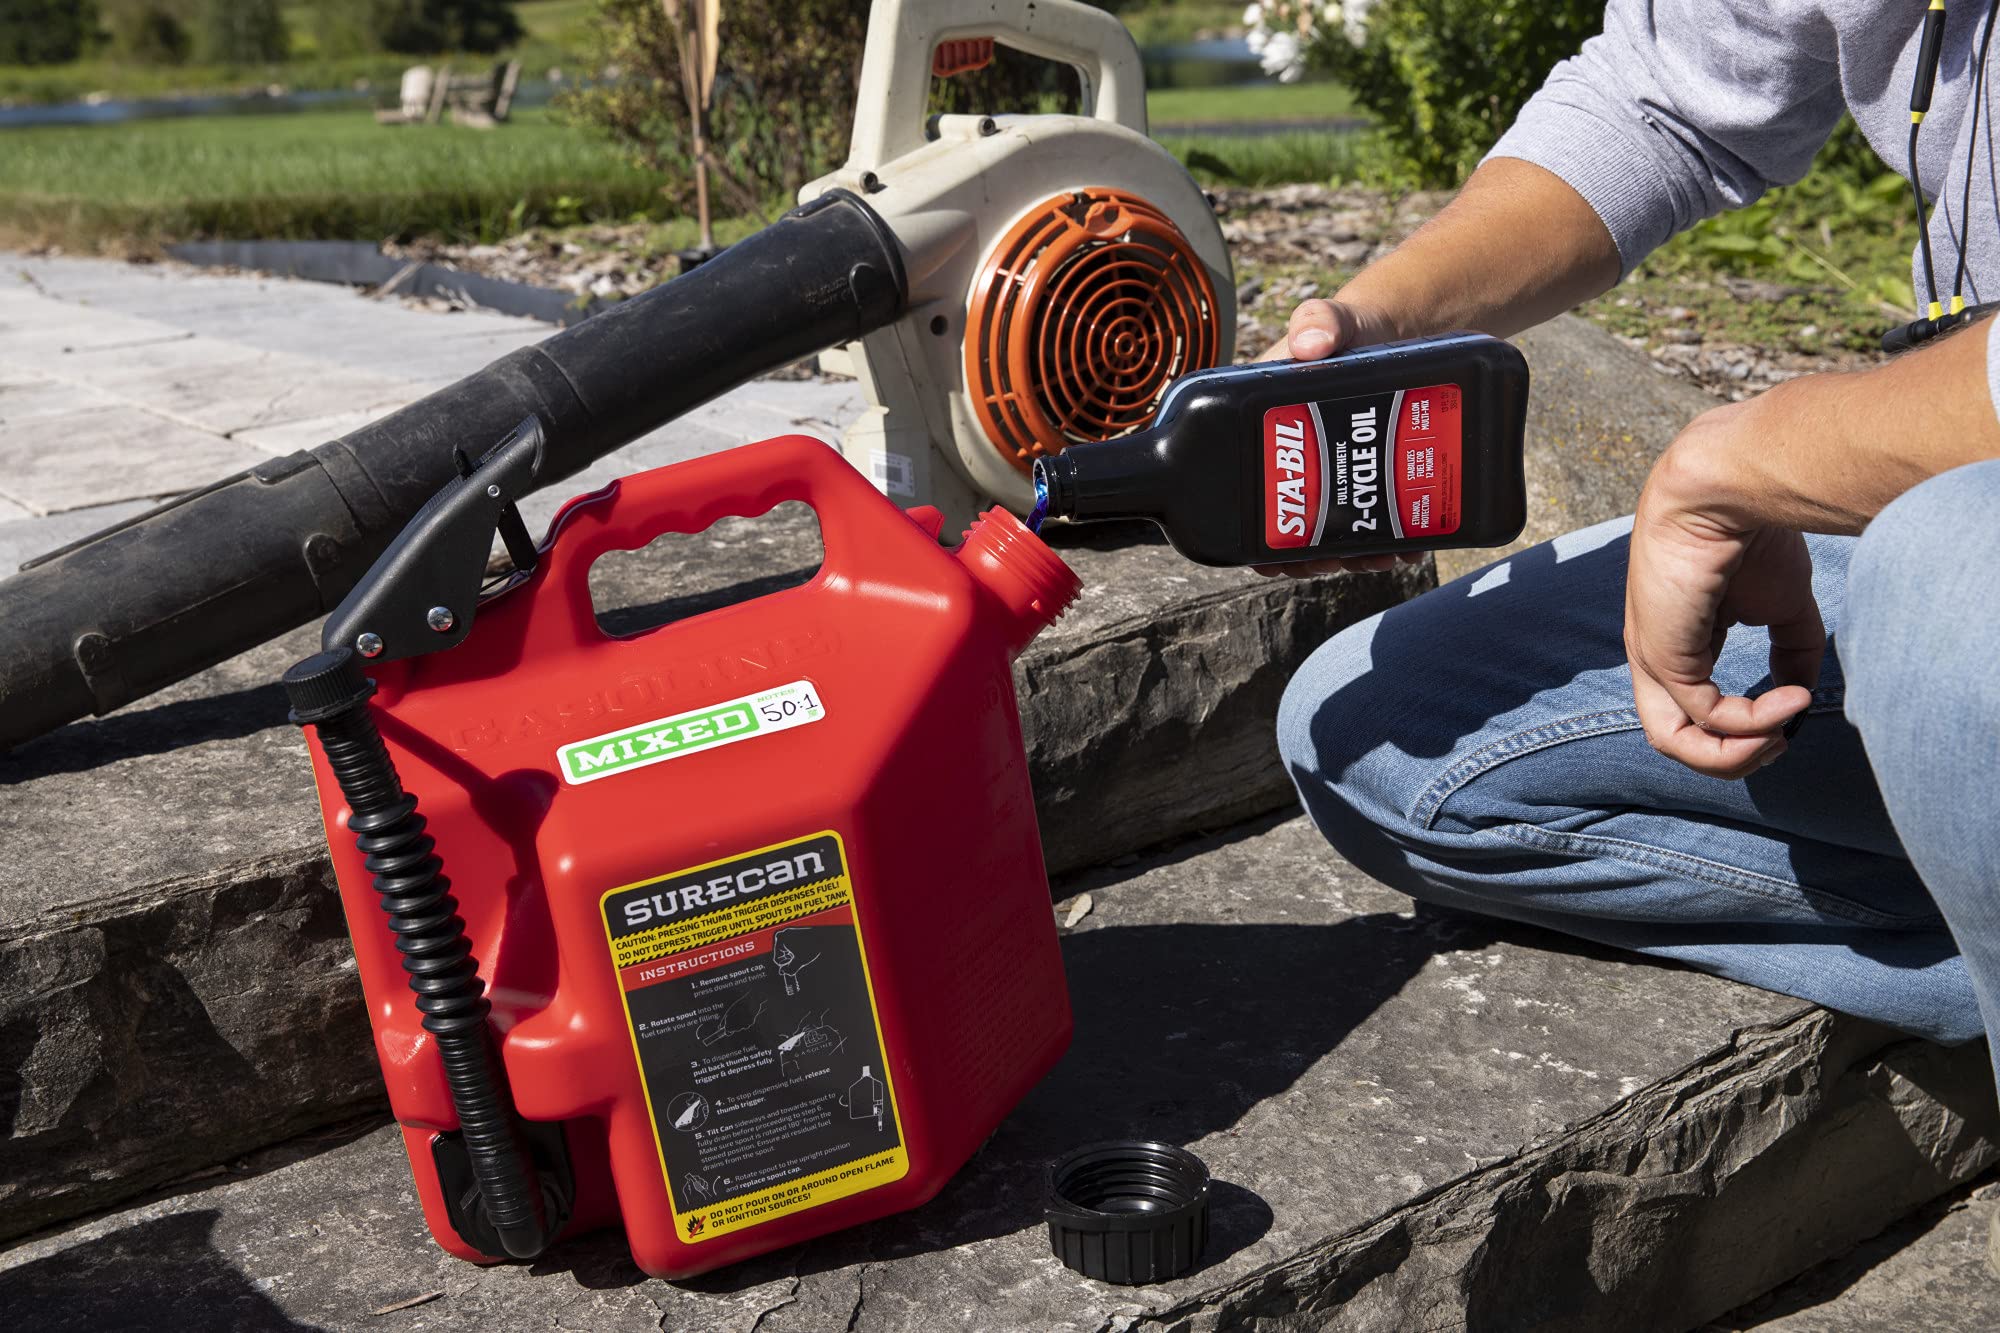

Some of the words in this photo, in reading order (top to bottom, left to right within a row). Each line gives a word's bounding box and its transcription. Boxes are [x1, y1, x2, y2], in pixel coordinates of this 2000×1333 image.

[1351, 407, 1377, 443] OIL
[1411, 402, 1420, 425] GALLON
[1421, 399, 1430, 431] MULTI-MIX
[1336, 441, 1347, 485] SYNTHETIC
[1407, 449, 1415, 480] STABILIZES
[1416, 451, 1425, 462] FOR
[1416, 463, 1425, 477] FUEL
[1425, 447, 1434, 471] MONTHS
[1276, 420, 1306, 537] STA-BIL
[1352, 447, 1378, 532] 2-CYCLE
[1425, 471, 1434, 479] 12
[1338, 486, 1347, 505] FULL
[1421, 494, 1430, 528] PROTECTION
[1412, 499, 1421, 526] ETHANOL
[760, 693, 818, 722] 50:1
[575, 709, 752, 772] MIXED
[615, 932, 657, 951] CAUTION:
[657, 920, 700, 939] PRESSING
[700, 911, 732, 927] THUMB
[732, 900, 769, 918] TRIGGER
[769, 887, 815, 907] DISPENSES
[816, 881, 839, 894] FUEL!
[618, 950, 632, 961] DO
[632, 945, 651, 958] NOT
[651, 933, 691, 952] DEPRESS
[691, 923, 728, 941] TRIGGER
[728, 915, 755, 930] UNTIL
[754, 907, 783, 923] SPOUT
[783, 904, 792, 914] IS
[792, 901, 802, 912] IN
[803, 895, 824, 908] FUEL
[824, 889, 847, 902] TANK
[639, 940, 755, 982] INSTRUCTIONS
[690, 981, 697, 989] 1.
[699, 972, 728, 986] Remove
[728, 967, 749, 979] spout
[693, 987, 713, 998] press
[713, 981, 733, 991] down
[733, 977, 747, 985] and
[638, 1022, 648, 1031] 2.
[650, 1014, 675, 1028] Rotate
[675, 1009, 697, 1022] spout
[696, 1005, 711, 1014] into
[711, 1001, 724, 1010] the
[640, 1029, 656, 1039] fuel
[655, 1025, 671, 1035] tank
[671, 1022, 686, 1031] you
[690, 1060, 700, 1068] 3.
[702, 1057, 710, 1065] To
[710, 1048, 742, 1063] dispense
[692, 1067, 707, 1077] pull
[707, 1062, 725, 1072] back
[725, 1055, 748, 1067] thumb
[749, 1048, 772, 1061] safety
[694, 1072, 720, 1086] trigger
[726, 1061, 756, 1076] depress
[756, 1055, 775, 1067] fully.
[714, 1098, 725, 1107] 4.
[726, 1095, 735, 1103] To
[735, 1091, 752, 1102] stop
[751, 1080, 789, 1097] dispensing
[804, 1067, 830, 1079] release
[694, 1131, 704, 1140] 5.
[706, 1127, 719, 1136] Tilt
[719, 1123, 733, 1132] Can
[733, 1113, 766, 1129] sideways
[766, 1109, 780, 1118] and
[780, 1101, 808, 1114] towards
[808, 1094, 828, 1106] spout
[716, 1103, 740, 1115] thumb
[740, 1095, 766, 1109] trigger.
[696, 1138, 713, 1149] fully
[713, 1132, 732, 1143] drain
[732, 1125, 755, 1137] before
[755, 1114, 792, 1131] proceeding
[792, 1111, 800, 1119] to
[801, 1107, 816, 1117] step
[698, 1145, 718, 1155] Make
[718, 1141, 734, 1150] sure
[734, 1133, 755, 1146] spout
[761, 1124, 787, 1136] rotated
[802, 1114, 819, 1124] from
[819, 1110, 831, 1118] the
[700, 1151, 726, 1163] stowed
[756, 1134, 780, 1146] Ensure
[780, 1131, 790, 1139] all
[789, 1123, 817, 1136] residual
[817, 1118, 831, 1128] fuel
[702, 1159, 725, 1172] drains
[724, 1154, 742, 1165] from
[742, 1150, 754, 1159] the
[722, 1176, 733, 1185] 6.
[734, 1169, 758, 1181] Rotate
[758, 1163, 778, 1176] spout
[786, 1157, 798, 1166] the
[798, 1149, 823, 1163] upright
[823, 1141, 851, 1155] position
[709, 1209, 723, 1219] DO
[724, 1203, 744, 1215] NOT
[745, 1195, 771, 1209] POUR
[771, 1190, 785, 1201] ON
[786, 1186, 800, 1196] OR
[800, 1174, 838, 1191] AROUND
[838, 1166, 862, 1179] OPEN
[864, 1156, 894, 1171] FLAME
[725, 1184, 738, 1193] and
[738, 1175, 766, 1190] replace
[766, 1169, 787, 1181] spout
[787, 1165, 802, 1175] cap.
[711, 1218, 725, 1228] OR
[726, 1205, 766, 1224] IGNITION
[767, 1192, 811, 1211] SOURCES!
